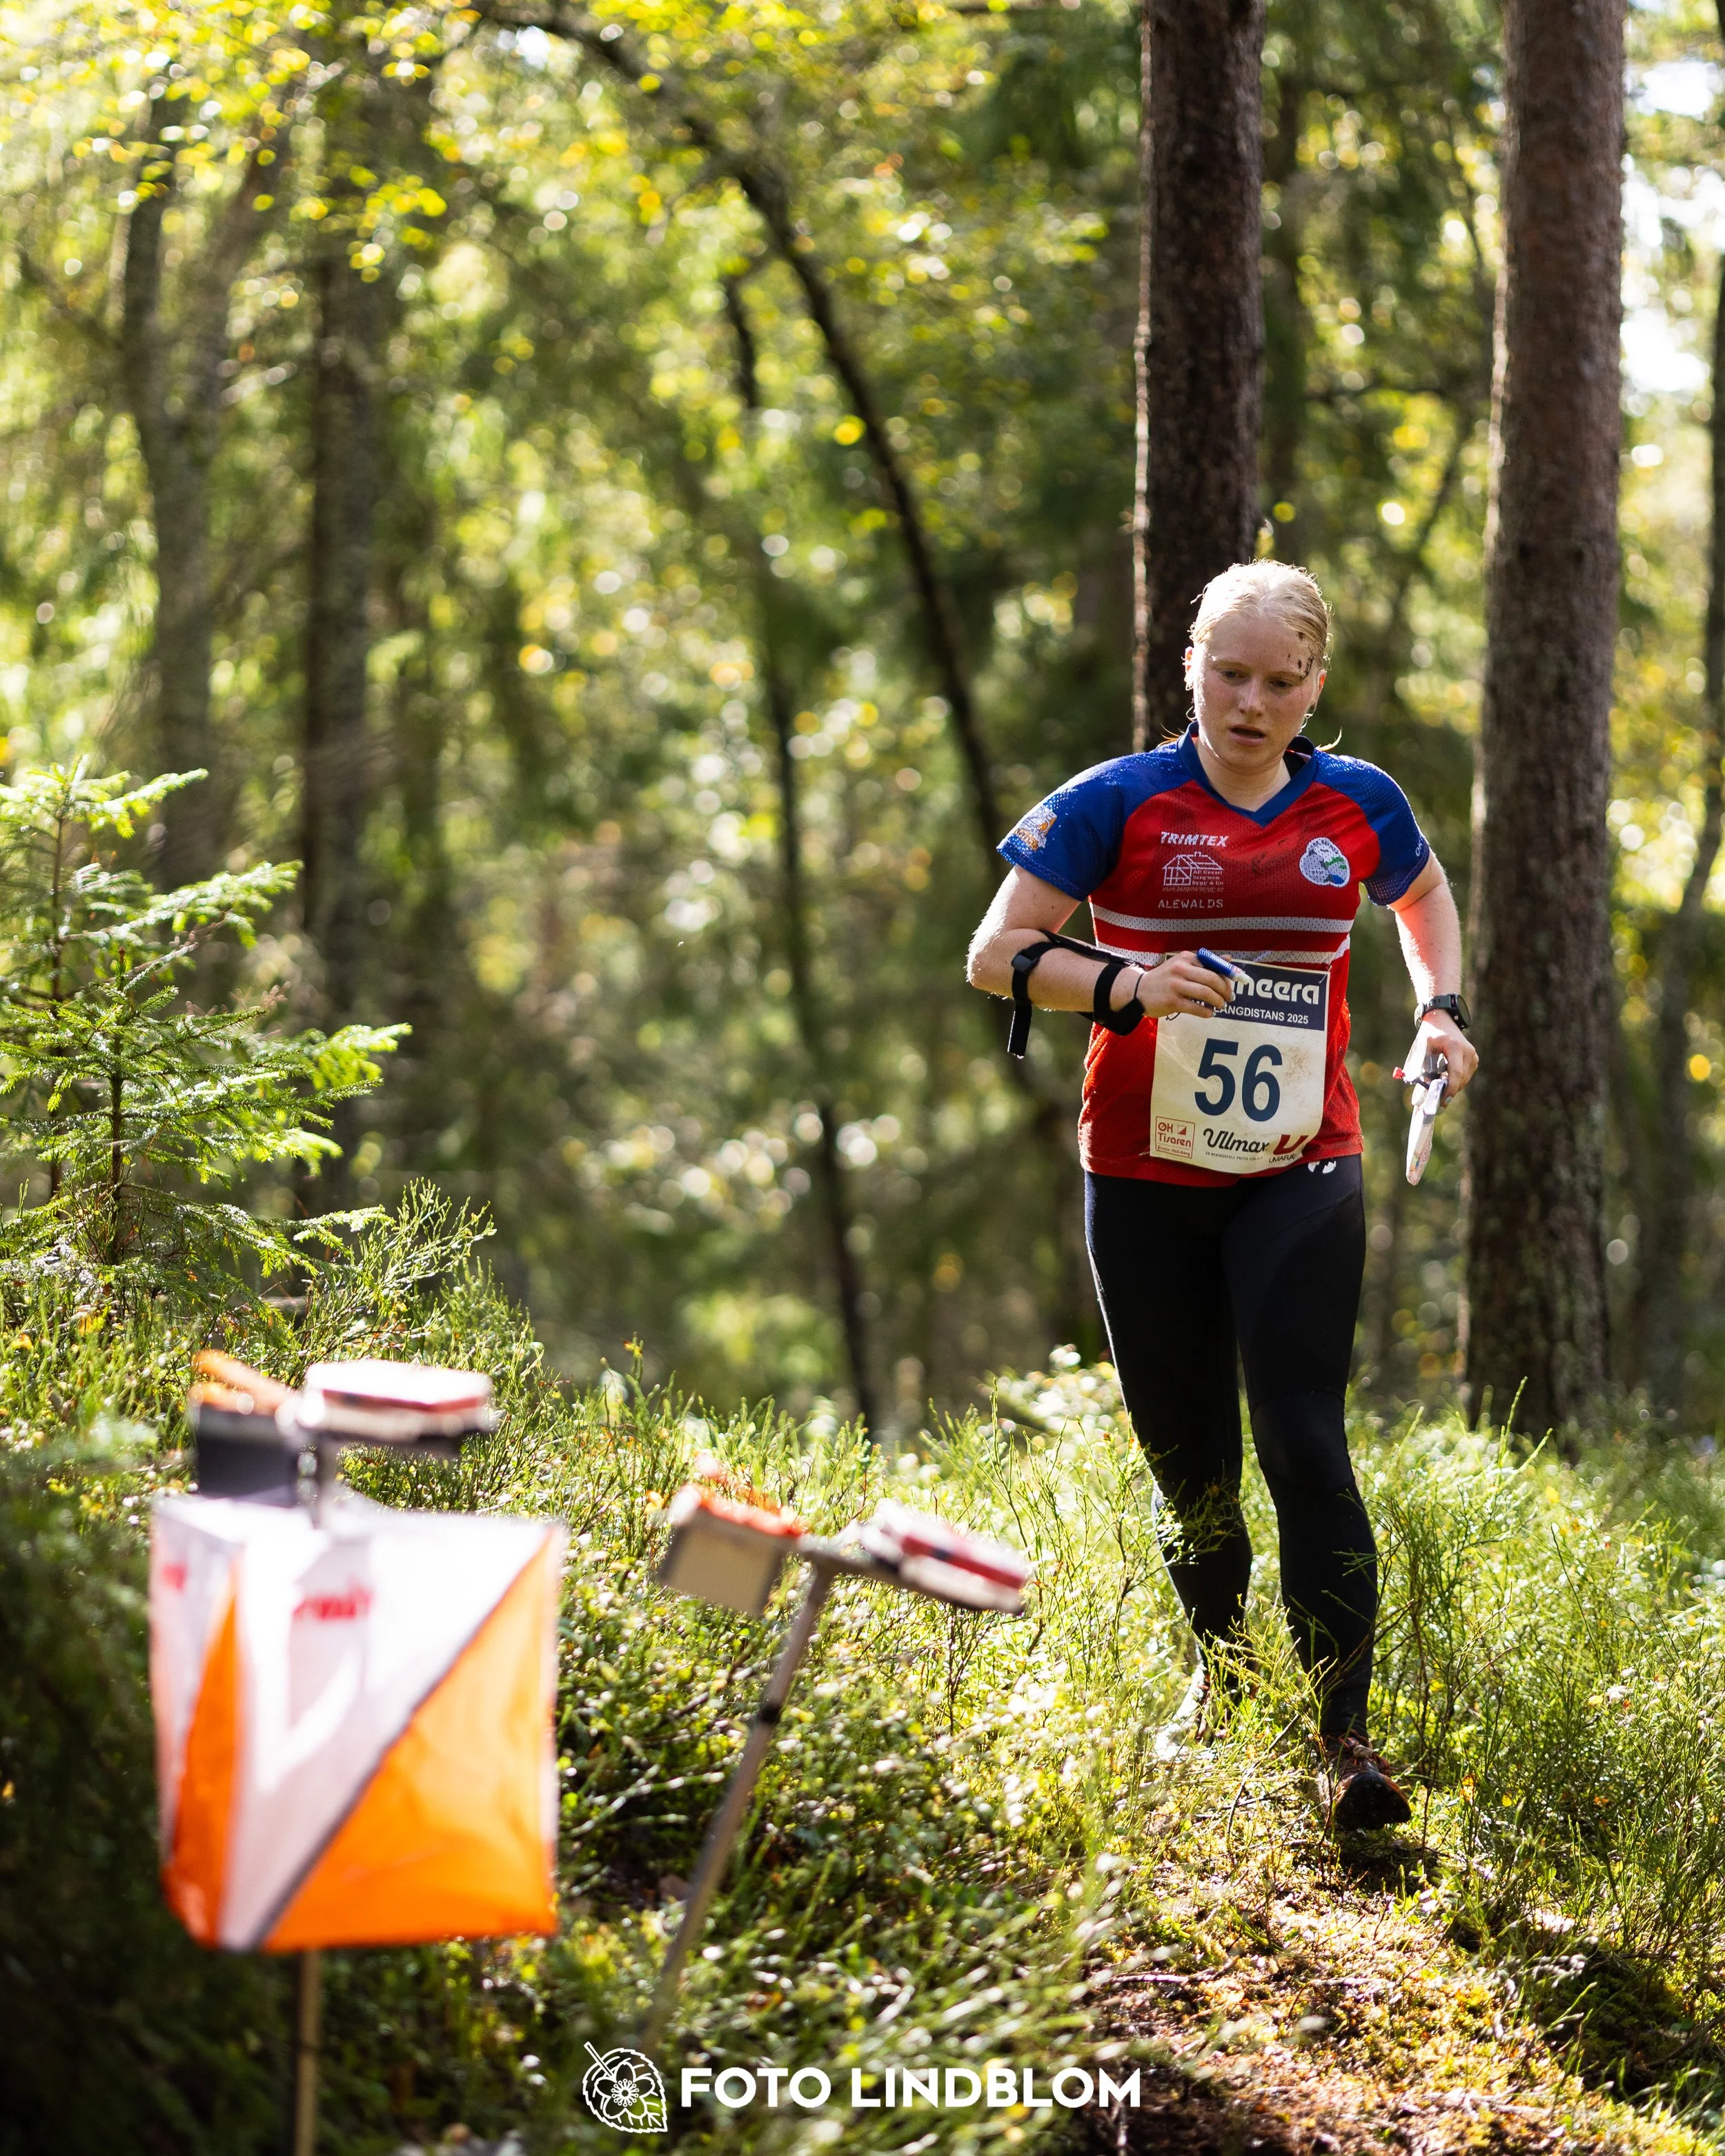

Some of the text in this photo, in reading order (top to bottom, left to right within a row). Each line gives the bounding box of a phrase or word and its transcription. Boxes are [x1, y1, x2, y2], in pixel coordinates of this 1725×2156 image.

[1161, 831, 1228, 847] TRIMTEX
[1158, 899, 1223, 909] ALEWALDS
[1230, 977, 1320, 1005] neera
[1287, 1012, 1309, 1025] 2025
[1194, 1038, 1283, 1122] 56
[1158, 1132, 1191, 1147] Tisaren
[1203, 1127, 1270, 1153] Ullmax
